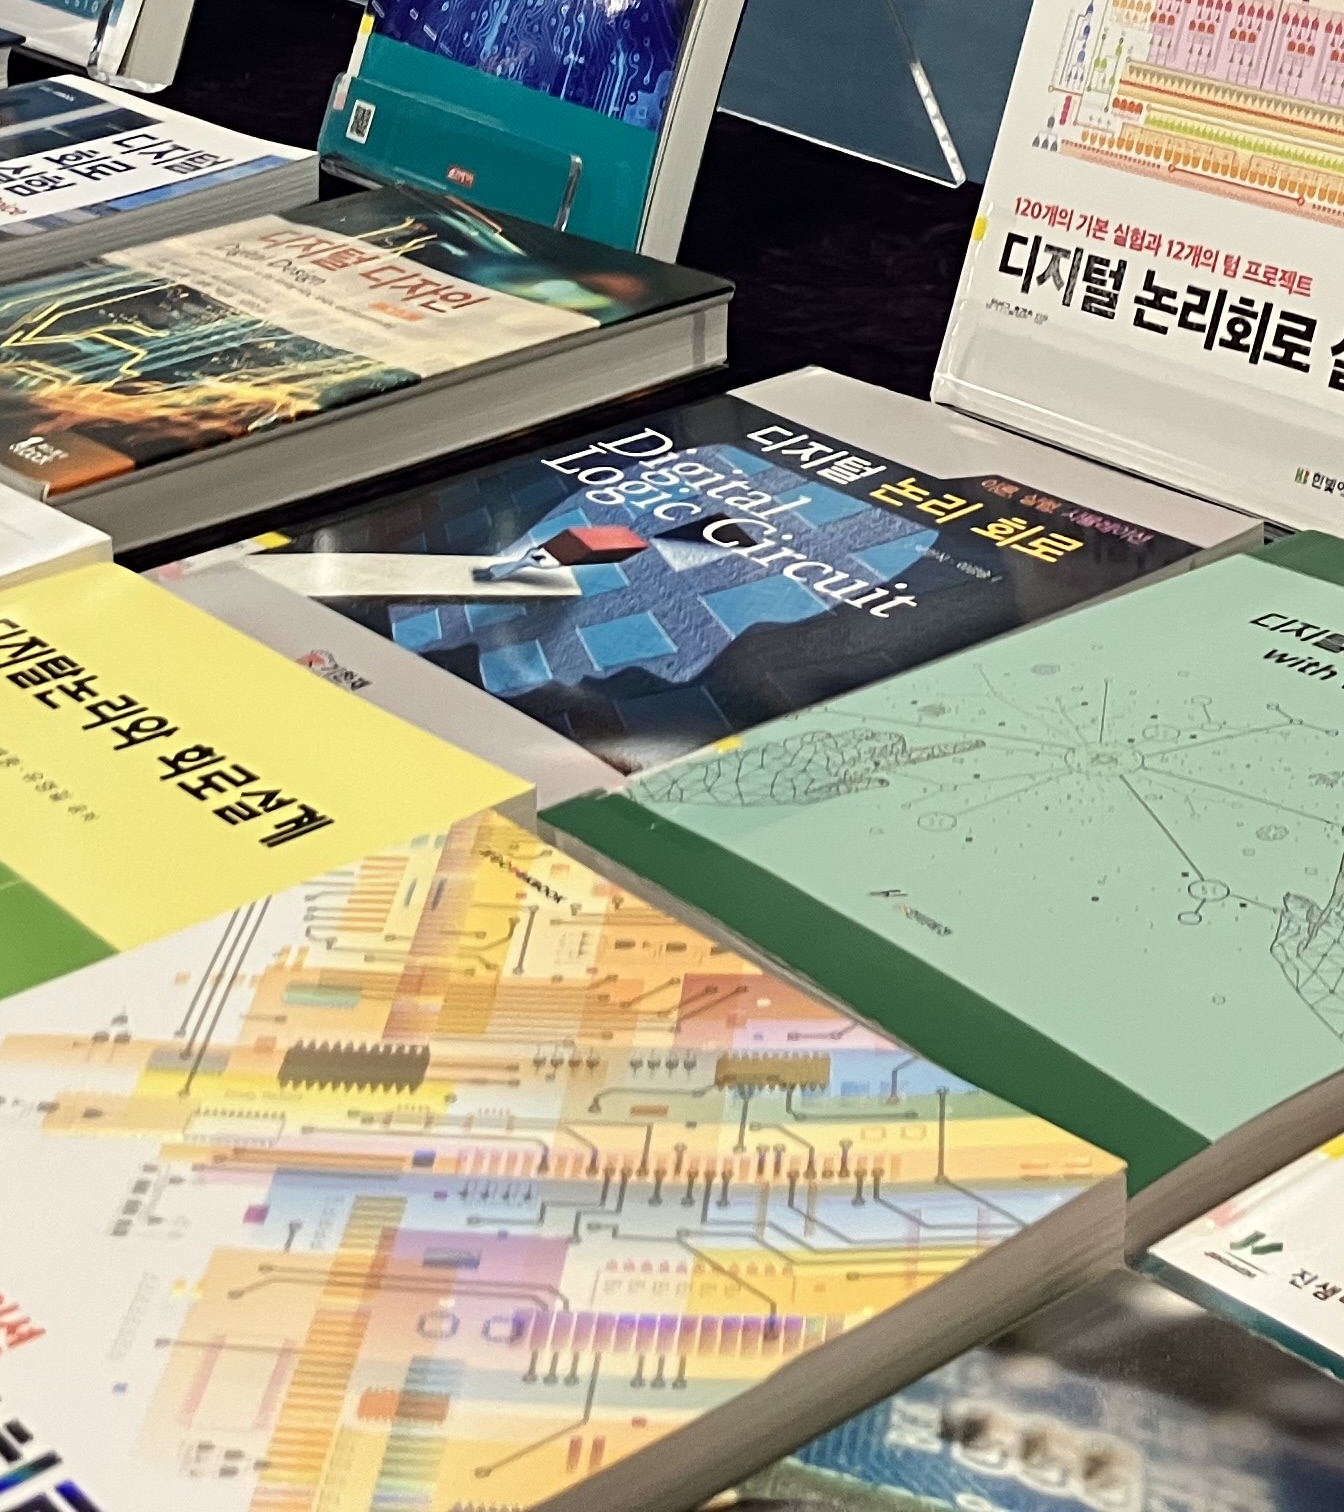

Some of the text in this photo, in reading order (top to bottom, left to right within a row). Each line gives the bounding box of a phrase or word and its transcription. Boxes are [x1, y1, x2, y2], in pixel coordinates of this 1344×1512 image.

[42, 147, 133, 184] 회로
[113, 132, 235, 176] 디지털
[258, 227, 364, 274] 디지털
[356, 258, 482, 314] 디자인
[1014, 196, 1074, 233] 120개의
[1074, 212, 1110, 241] 기본
[1113, 222, 1164, 254] 실험과
[1166, 238, 1221, 273] 12개의
[1242, 260, 1315, 299] 프로젝트
[997, 231, 1129, 322] 디지털
[1131, 267, 1319, 378] 논리회로
[594, 426, 814, 519] Digital
[744, 423, 880, 489] 디지털
[869, 474, 984, 529] 논리
[969, 517, 1086, 564] 회로
[540, 443, 704, 525] Logic
[699, 514, 921, 622] Circuit
[1262, 648, 1339, 681] with
[156, 743, 336, 850] 회로설계
